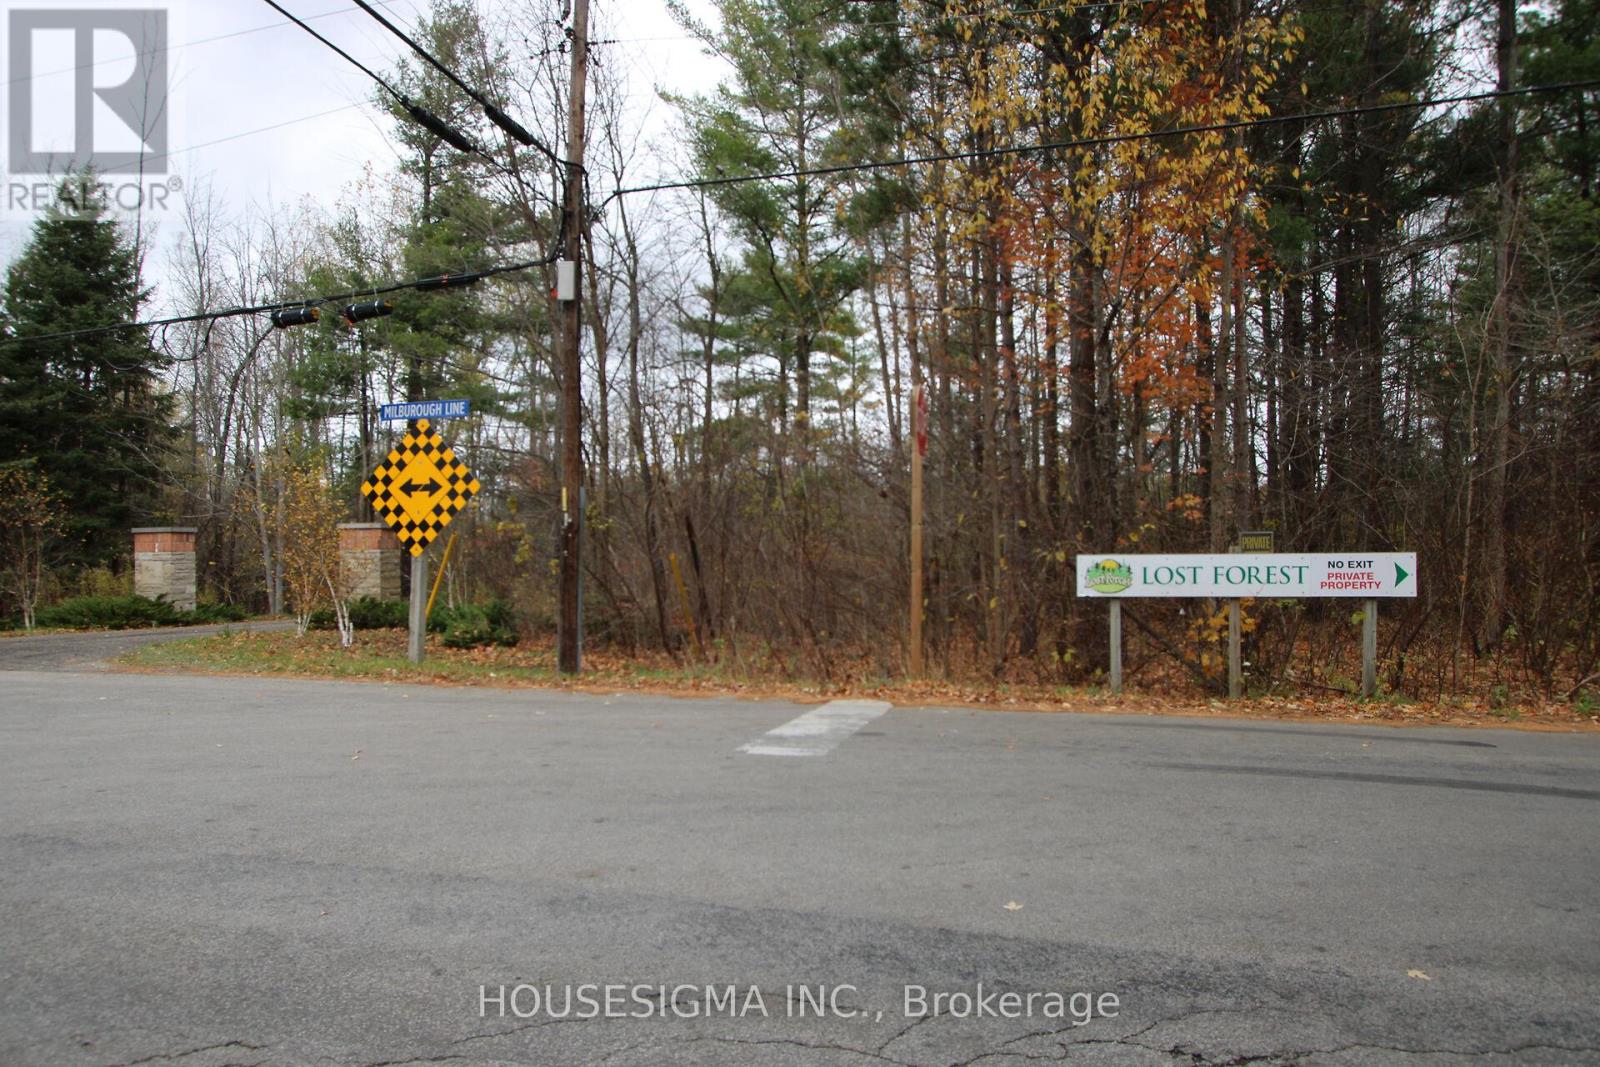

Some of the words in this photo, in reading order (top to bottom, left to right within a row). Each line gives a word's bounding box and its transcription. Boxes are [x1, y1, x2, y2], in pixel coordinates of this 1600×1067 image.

[384, 403, 442, 418] MILBUROUGH
[445, 401, 465, 415] LINE
[1241, 536, 1271, 549] PRIVATE
[1327, 561, 1344, 569] NO
[1347, 561, 1374, 569] EXIT
[1142, 566, 1203, 585] LOST
[1213, 566, 1309, 585] FOREST
[1327, 572, 1374, 580] PRIVATE
[1320, 581, 1382, 589] PROPERTY
